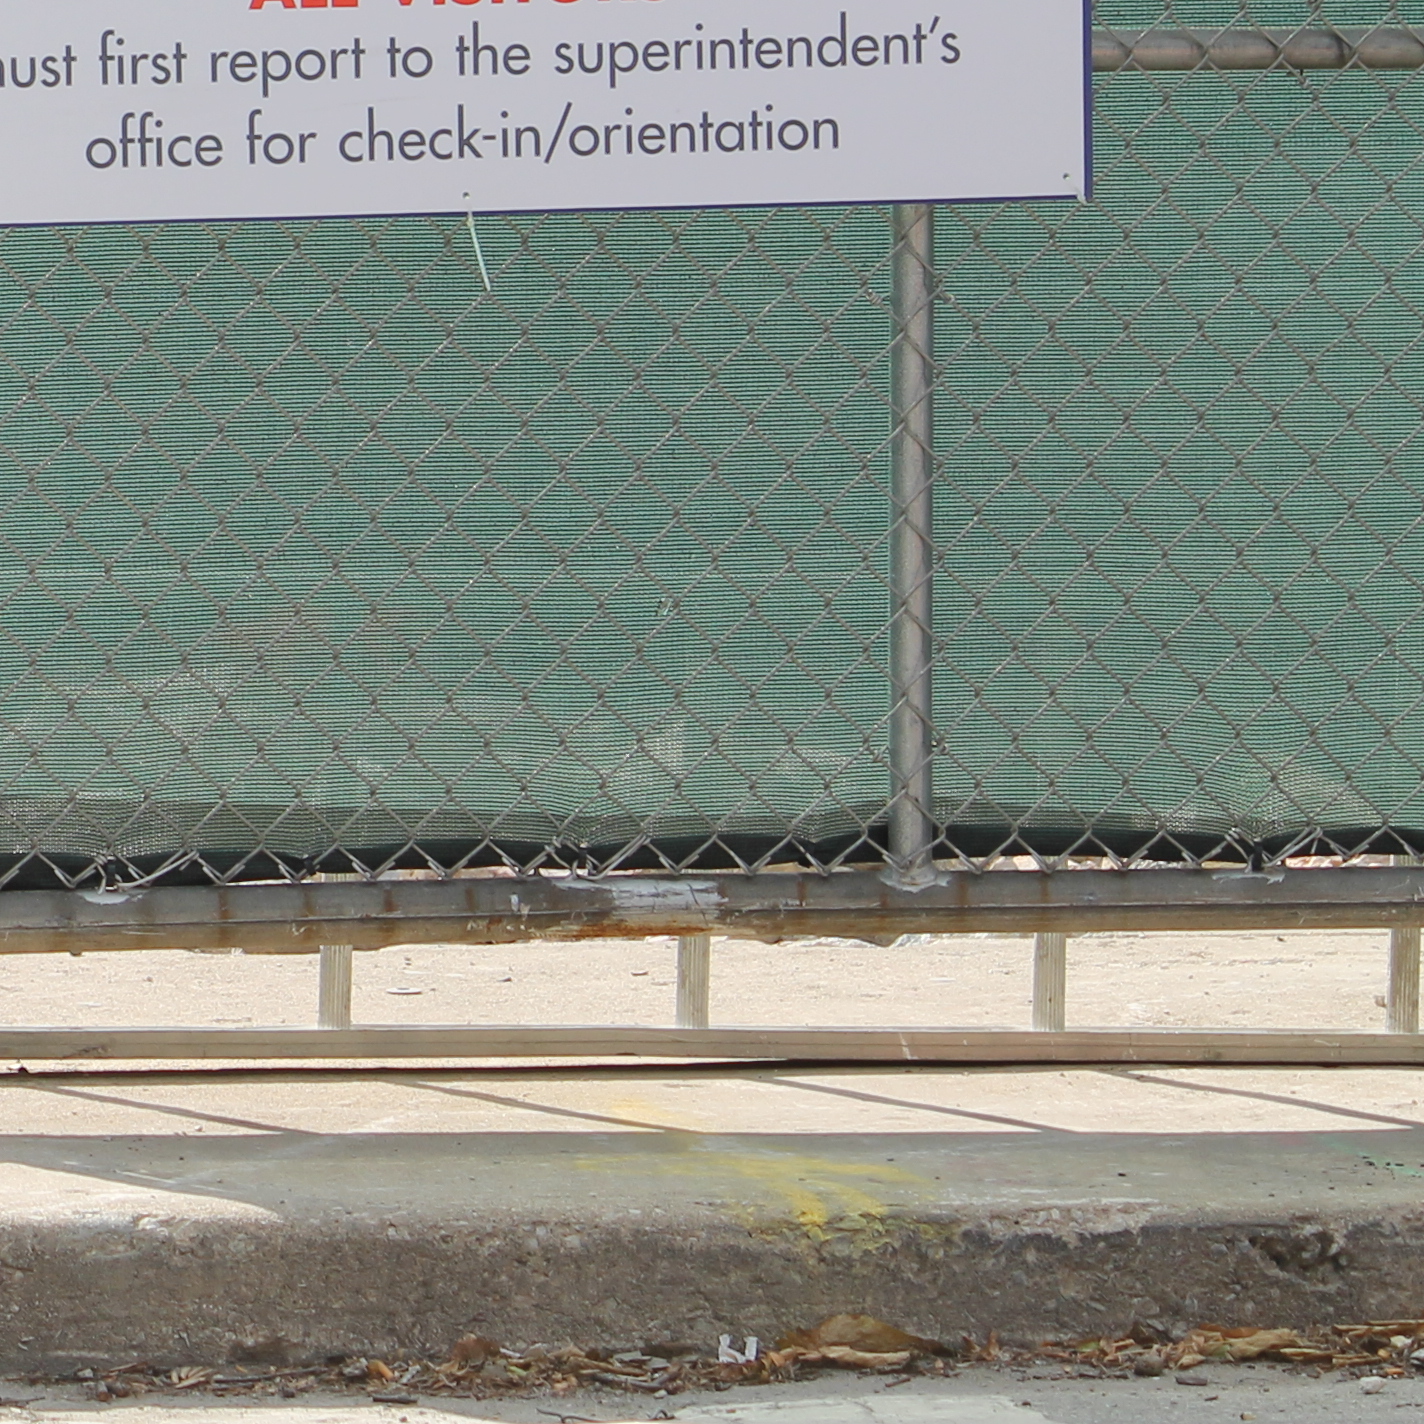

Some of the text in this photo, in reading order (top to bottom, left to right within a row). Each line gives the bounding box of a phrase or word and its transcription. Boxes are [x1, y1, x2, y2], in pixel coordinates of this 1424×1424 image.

[98, 30, 187, 85] first
[210, 37, 366, 97] report
[386, 36, 433, 78] to
[455, 21, 531, 76] the
[554, 11, 961, 89] superintendent's
[85, 101, 839, 169] office for check-in/orientation
